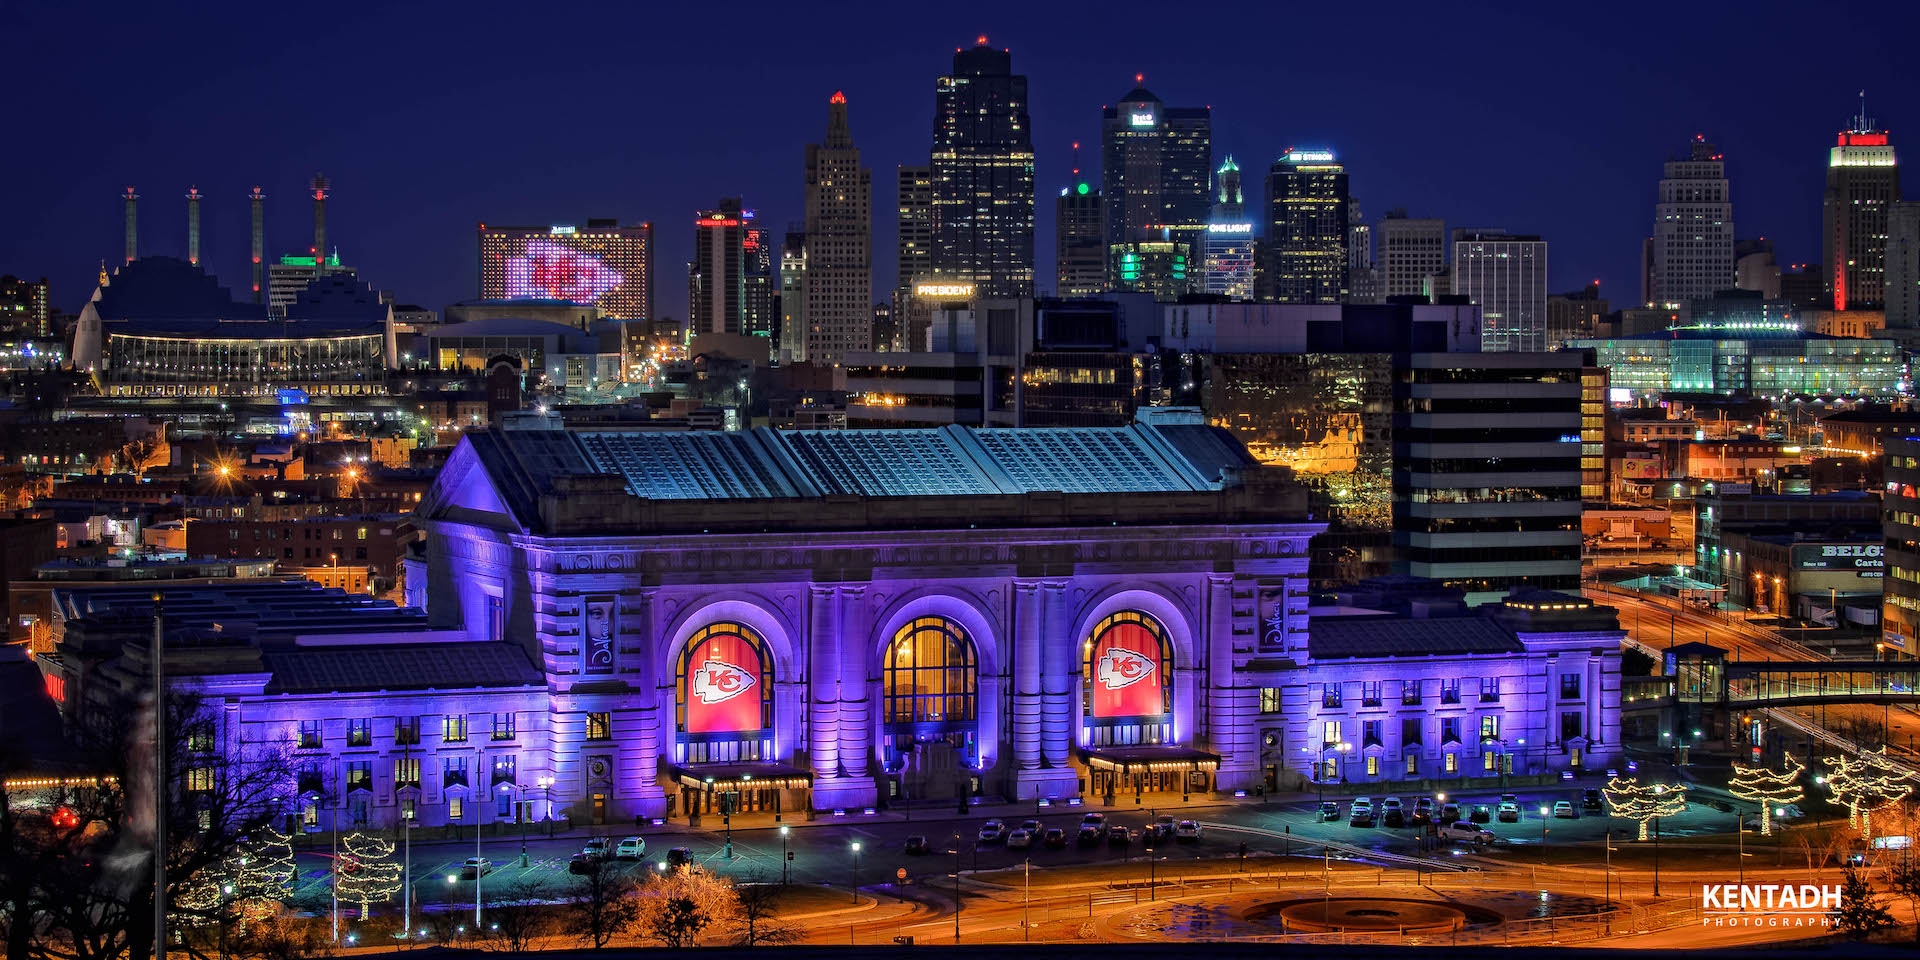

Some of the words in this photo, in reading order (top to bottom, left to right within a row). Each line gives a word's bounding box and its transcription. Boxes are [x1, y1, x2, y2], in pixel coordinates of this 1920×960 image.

[1209, 224, 1227, 232] ONE
[1227, 224, 1251, 232] LIGHT
[918, 285, 973, 296] PRESIDENT
[1112, 656, 1142, 678] KC
[708, 670, 741, 692] KC
